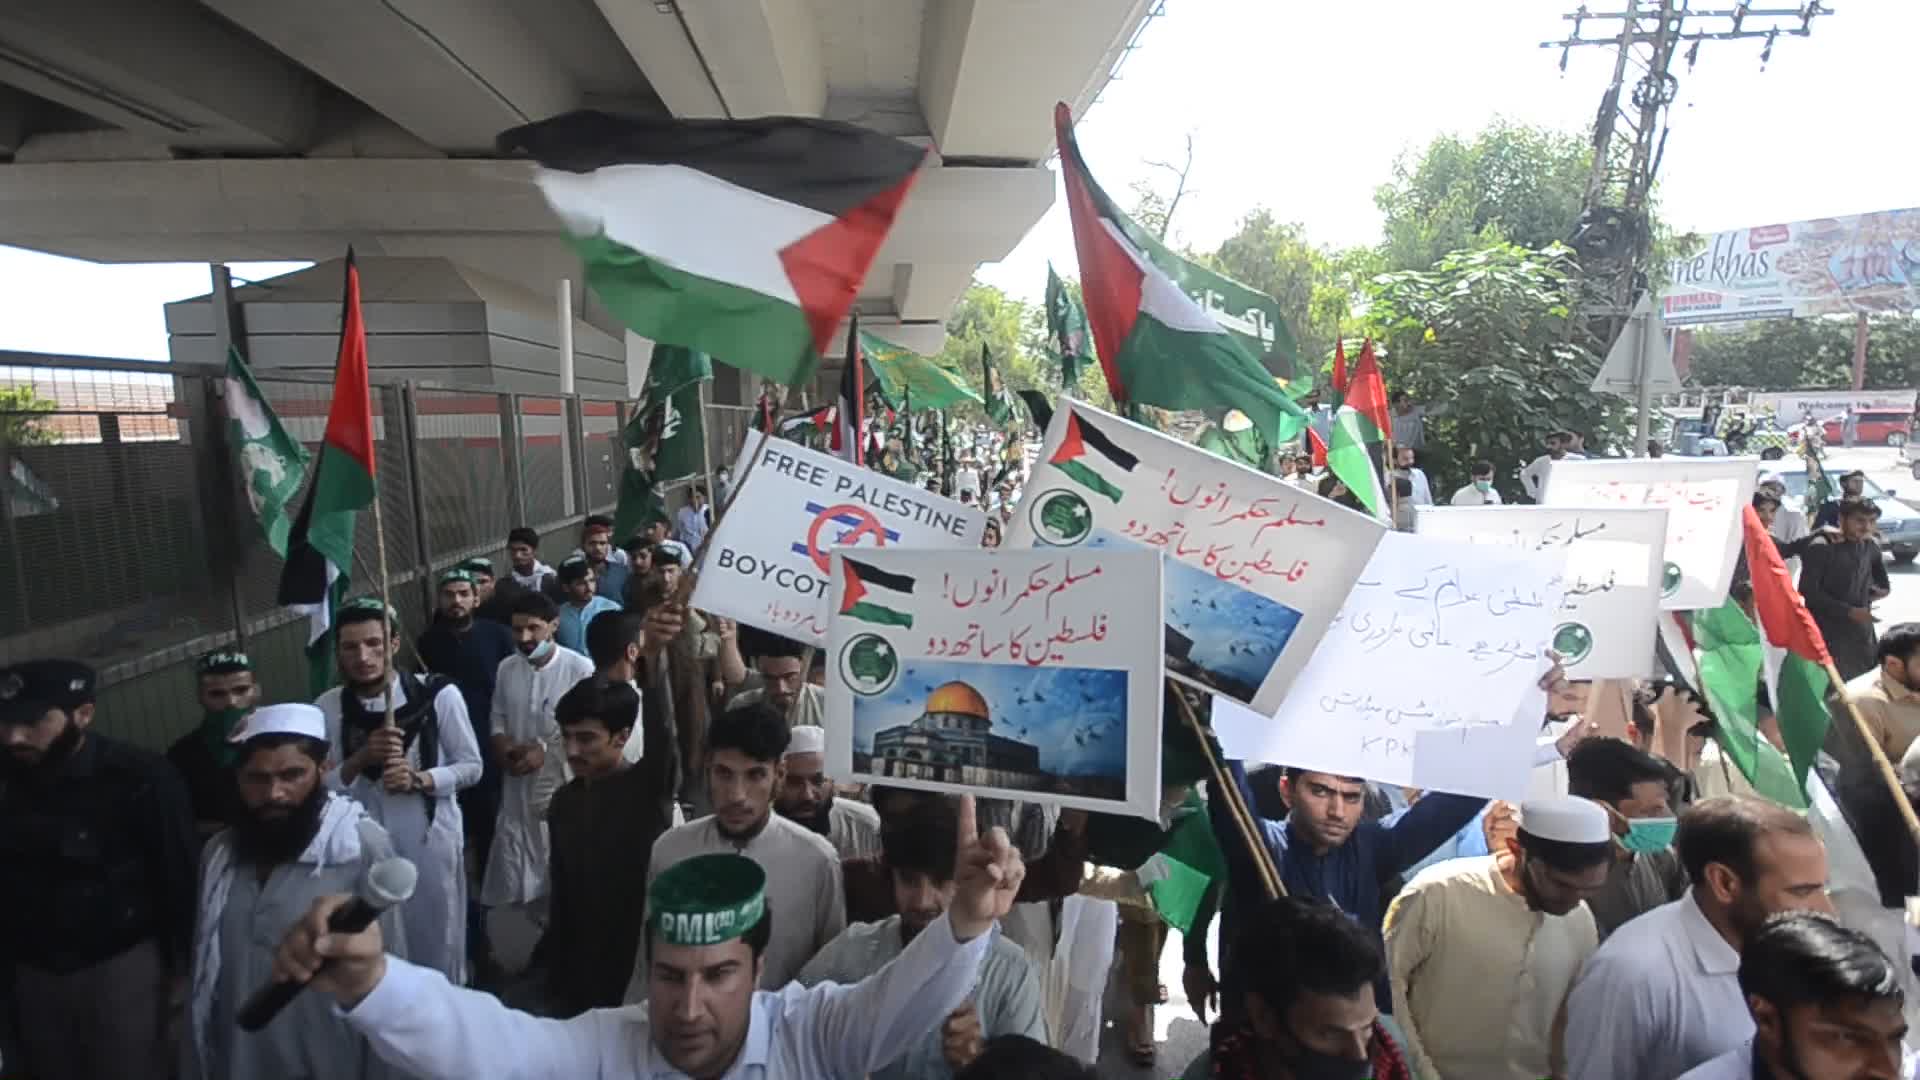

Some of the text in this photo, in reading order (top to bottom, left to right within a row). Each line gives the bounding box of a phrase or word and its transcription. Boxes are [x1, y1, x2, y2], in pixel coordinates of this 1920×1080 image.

[1709, 232, 1769, 288] khas
[761, 448, 968, 537] FREE PALESTINE
[1120, 519, 1309, 584] فلسطین کا ساتھ دو
[1251, 503, 1326, 547] مسلم
[718, 548, 830, 600] BOYCOT
[1046, 556, 1103, 621] مسلم
[1558, 569, 1615, 609] فلسطی
[925, 614, 1107, 667] فلسطین کا ساتھ دو
